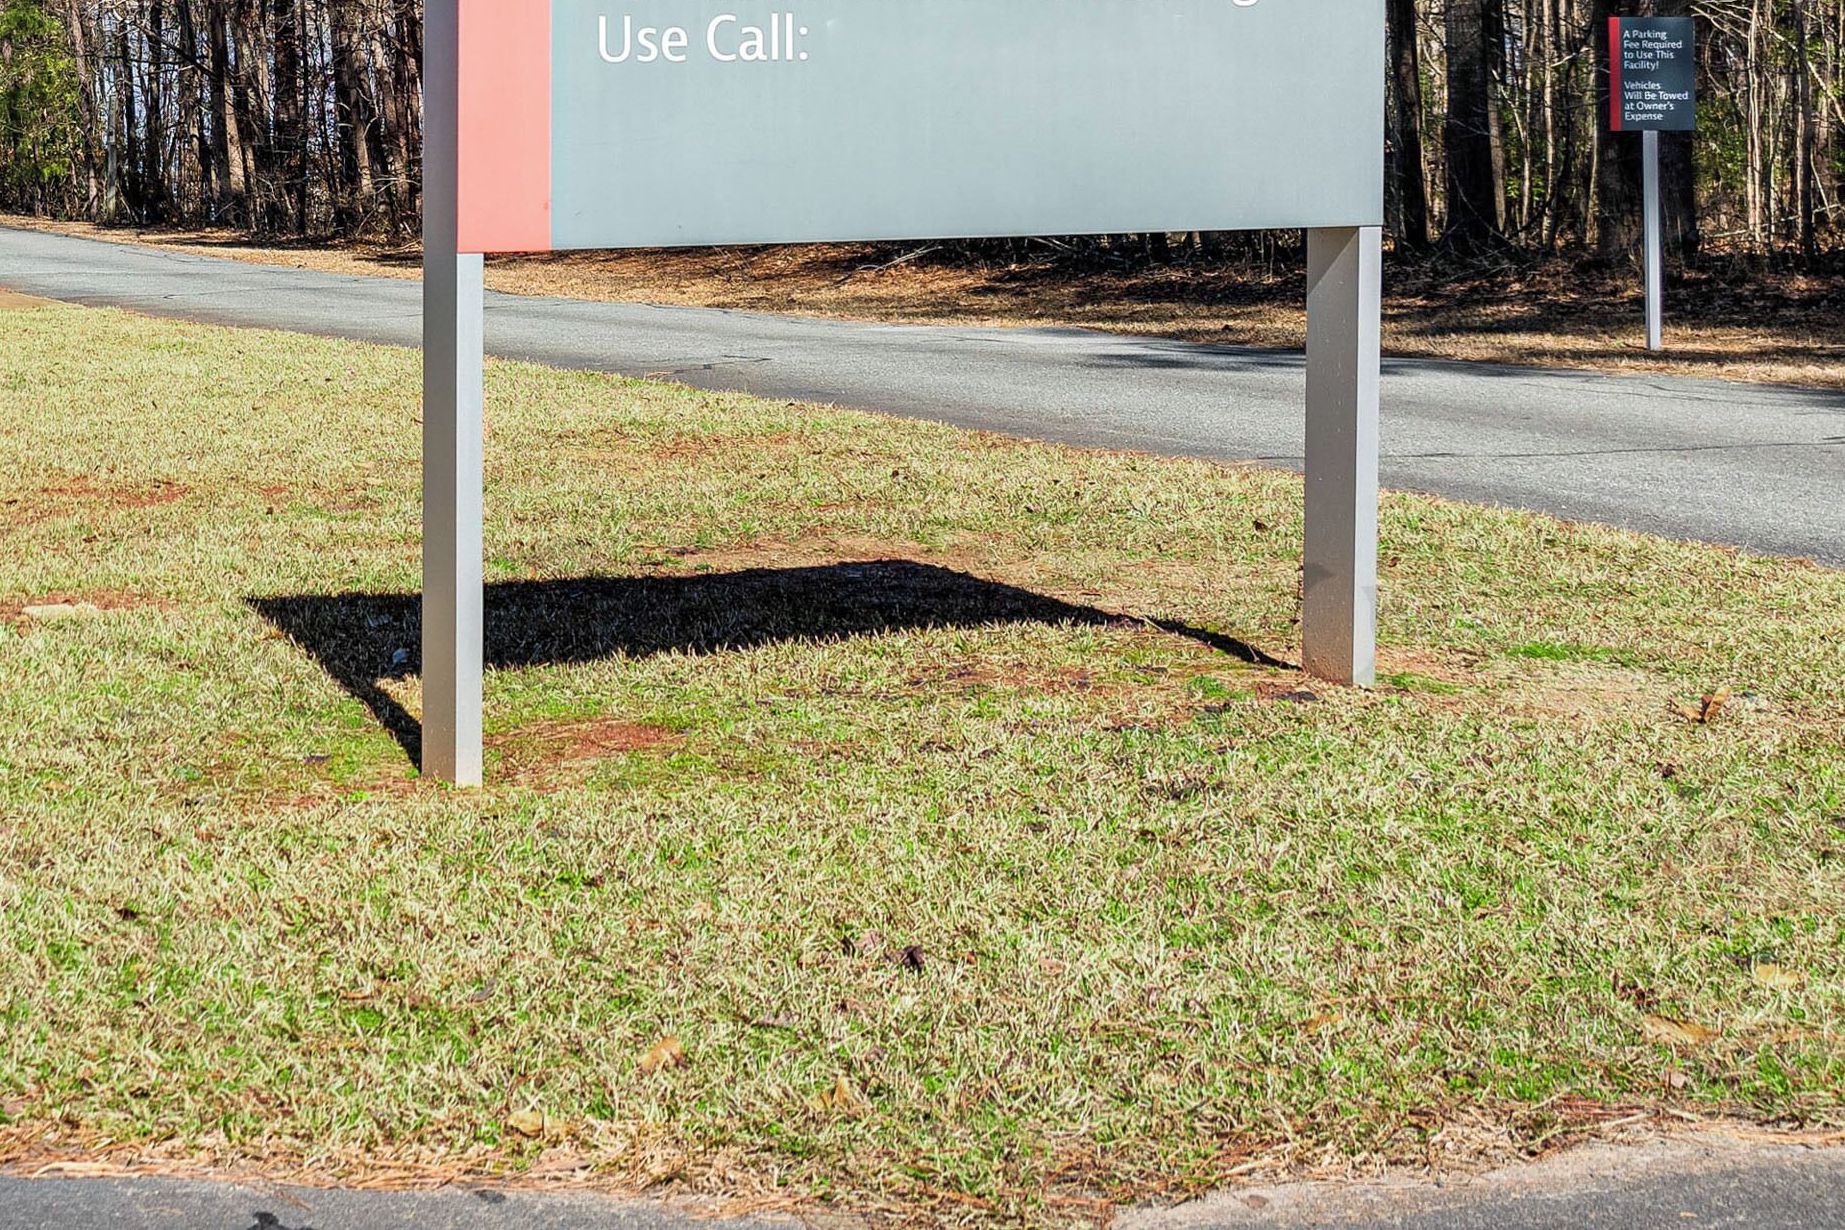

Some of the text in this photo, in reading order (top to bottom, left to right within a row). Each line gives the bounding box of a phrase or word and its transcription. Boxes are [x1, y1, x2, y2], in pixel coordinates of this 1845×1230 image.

[598, 12, 808, 63] Use Call:
[1623, 30, 1667, 39] A Parking
[1624, 40, 1682, 49] Fee Required
[1624, 51, 1633, 59] to
[1637, 51, 1653, 59] Use
[1624, 61, 1659, 71] Facility!
[1624, 81, 1660, 90] Vehicles
[1645, 91, 1656, 99] Be
[1625, 102, 1674, 110] at Owner's
[1625, 113, 1663, 121] Expense
